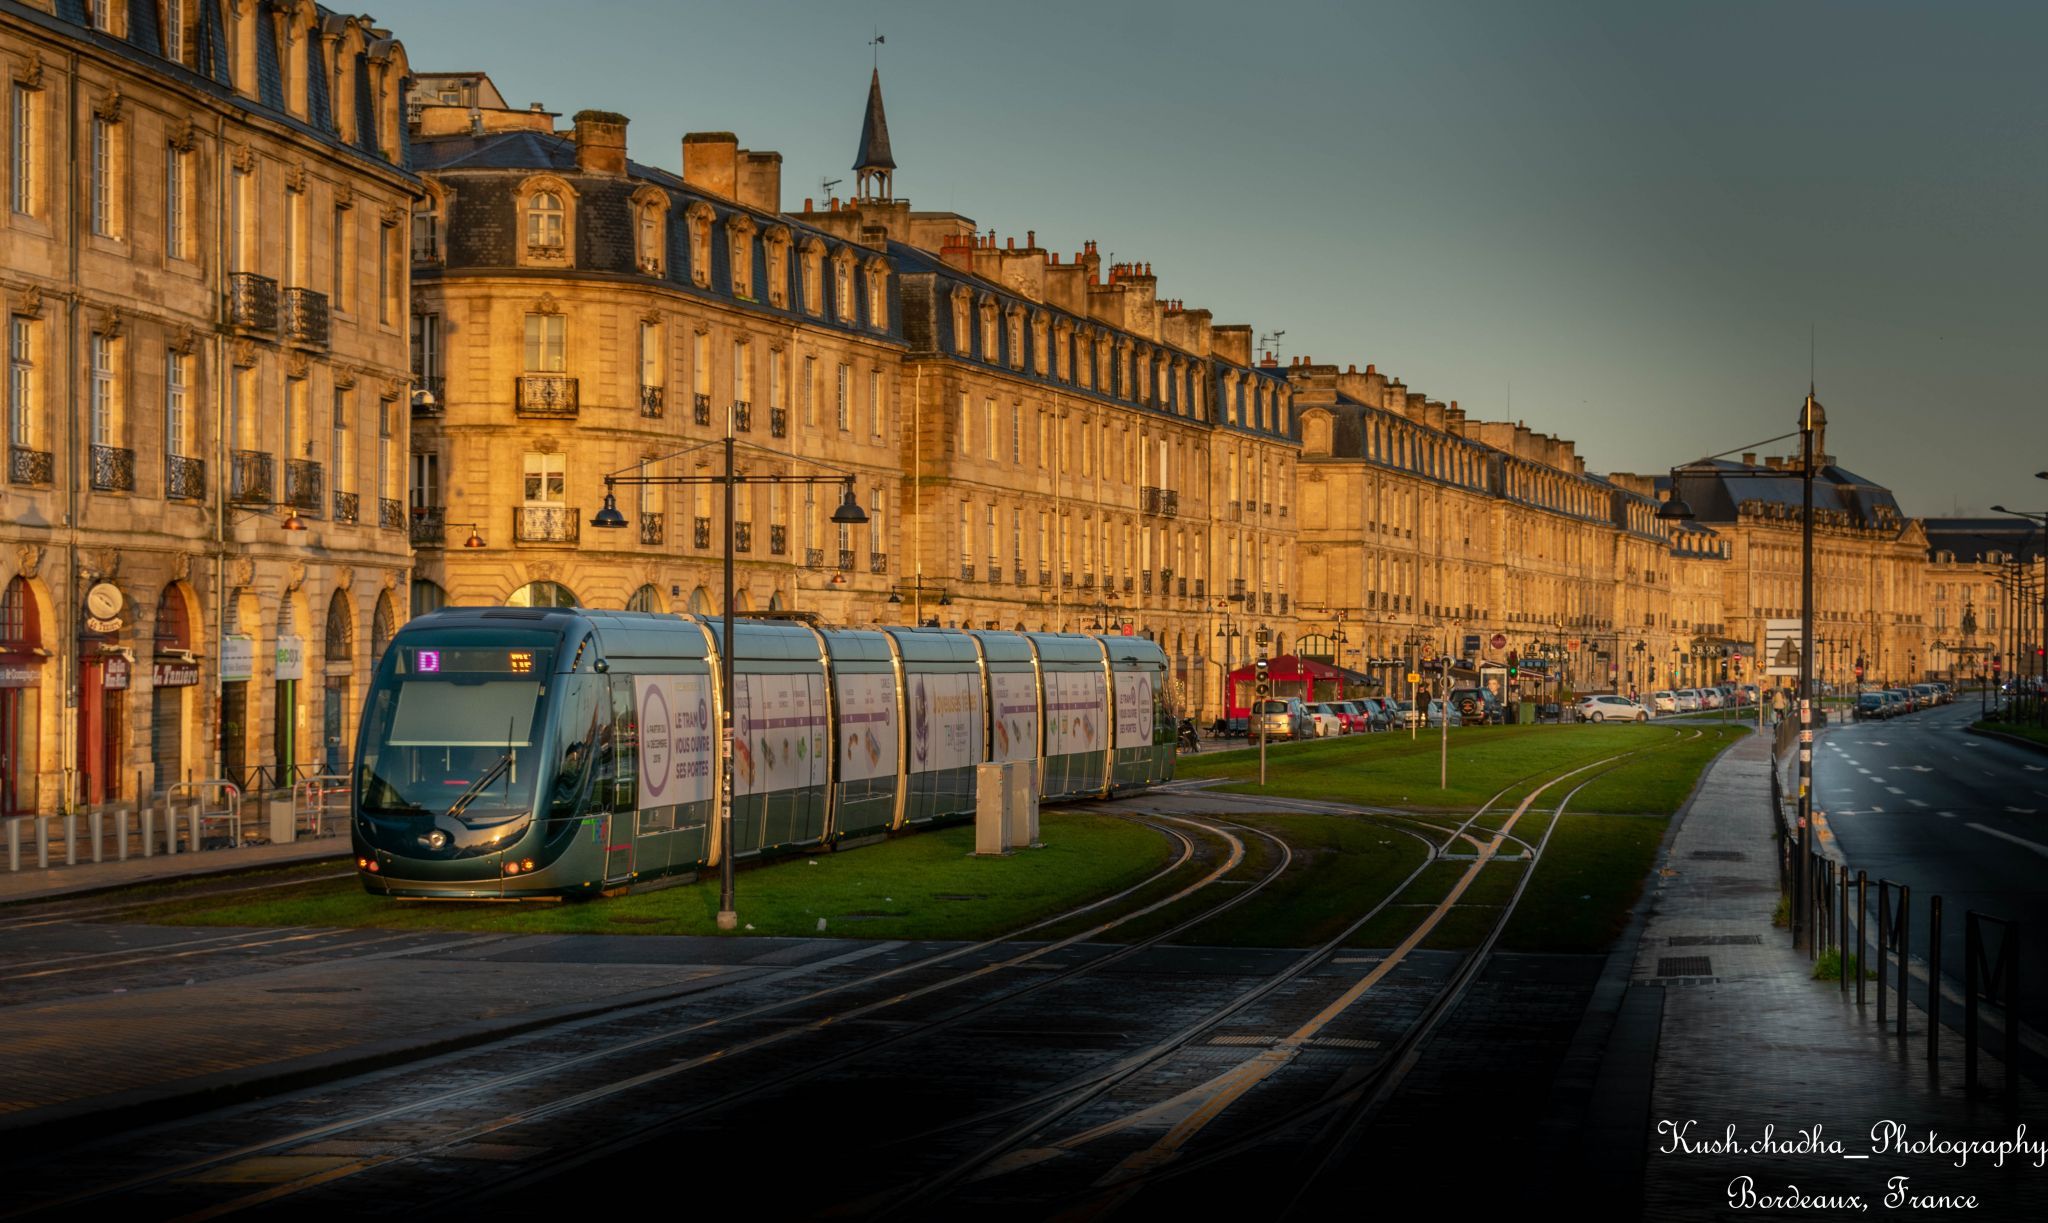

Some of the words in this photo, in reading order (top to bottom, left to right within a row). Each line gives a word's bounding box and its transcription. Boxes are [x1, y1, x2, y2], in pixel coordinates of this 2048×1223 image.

[419, 652, 438, 671] D
[163, 664, 198, 685] Tanière
[675, 711, 682, 729] LE
[683, 710, 699, 728] TRAM
[675, 736, 690, 753] VOUS
[691, 735, 710, 752] OUVRE
[676, 762, 686, 778] SES
[687, 760, 709, 778] PORTES
